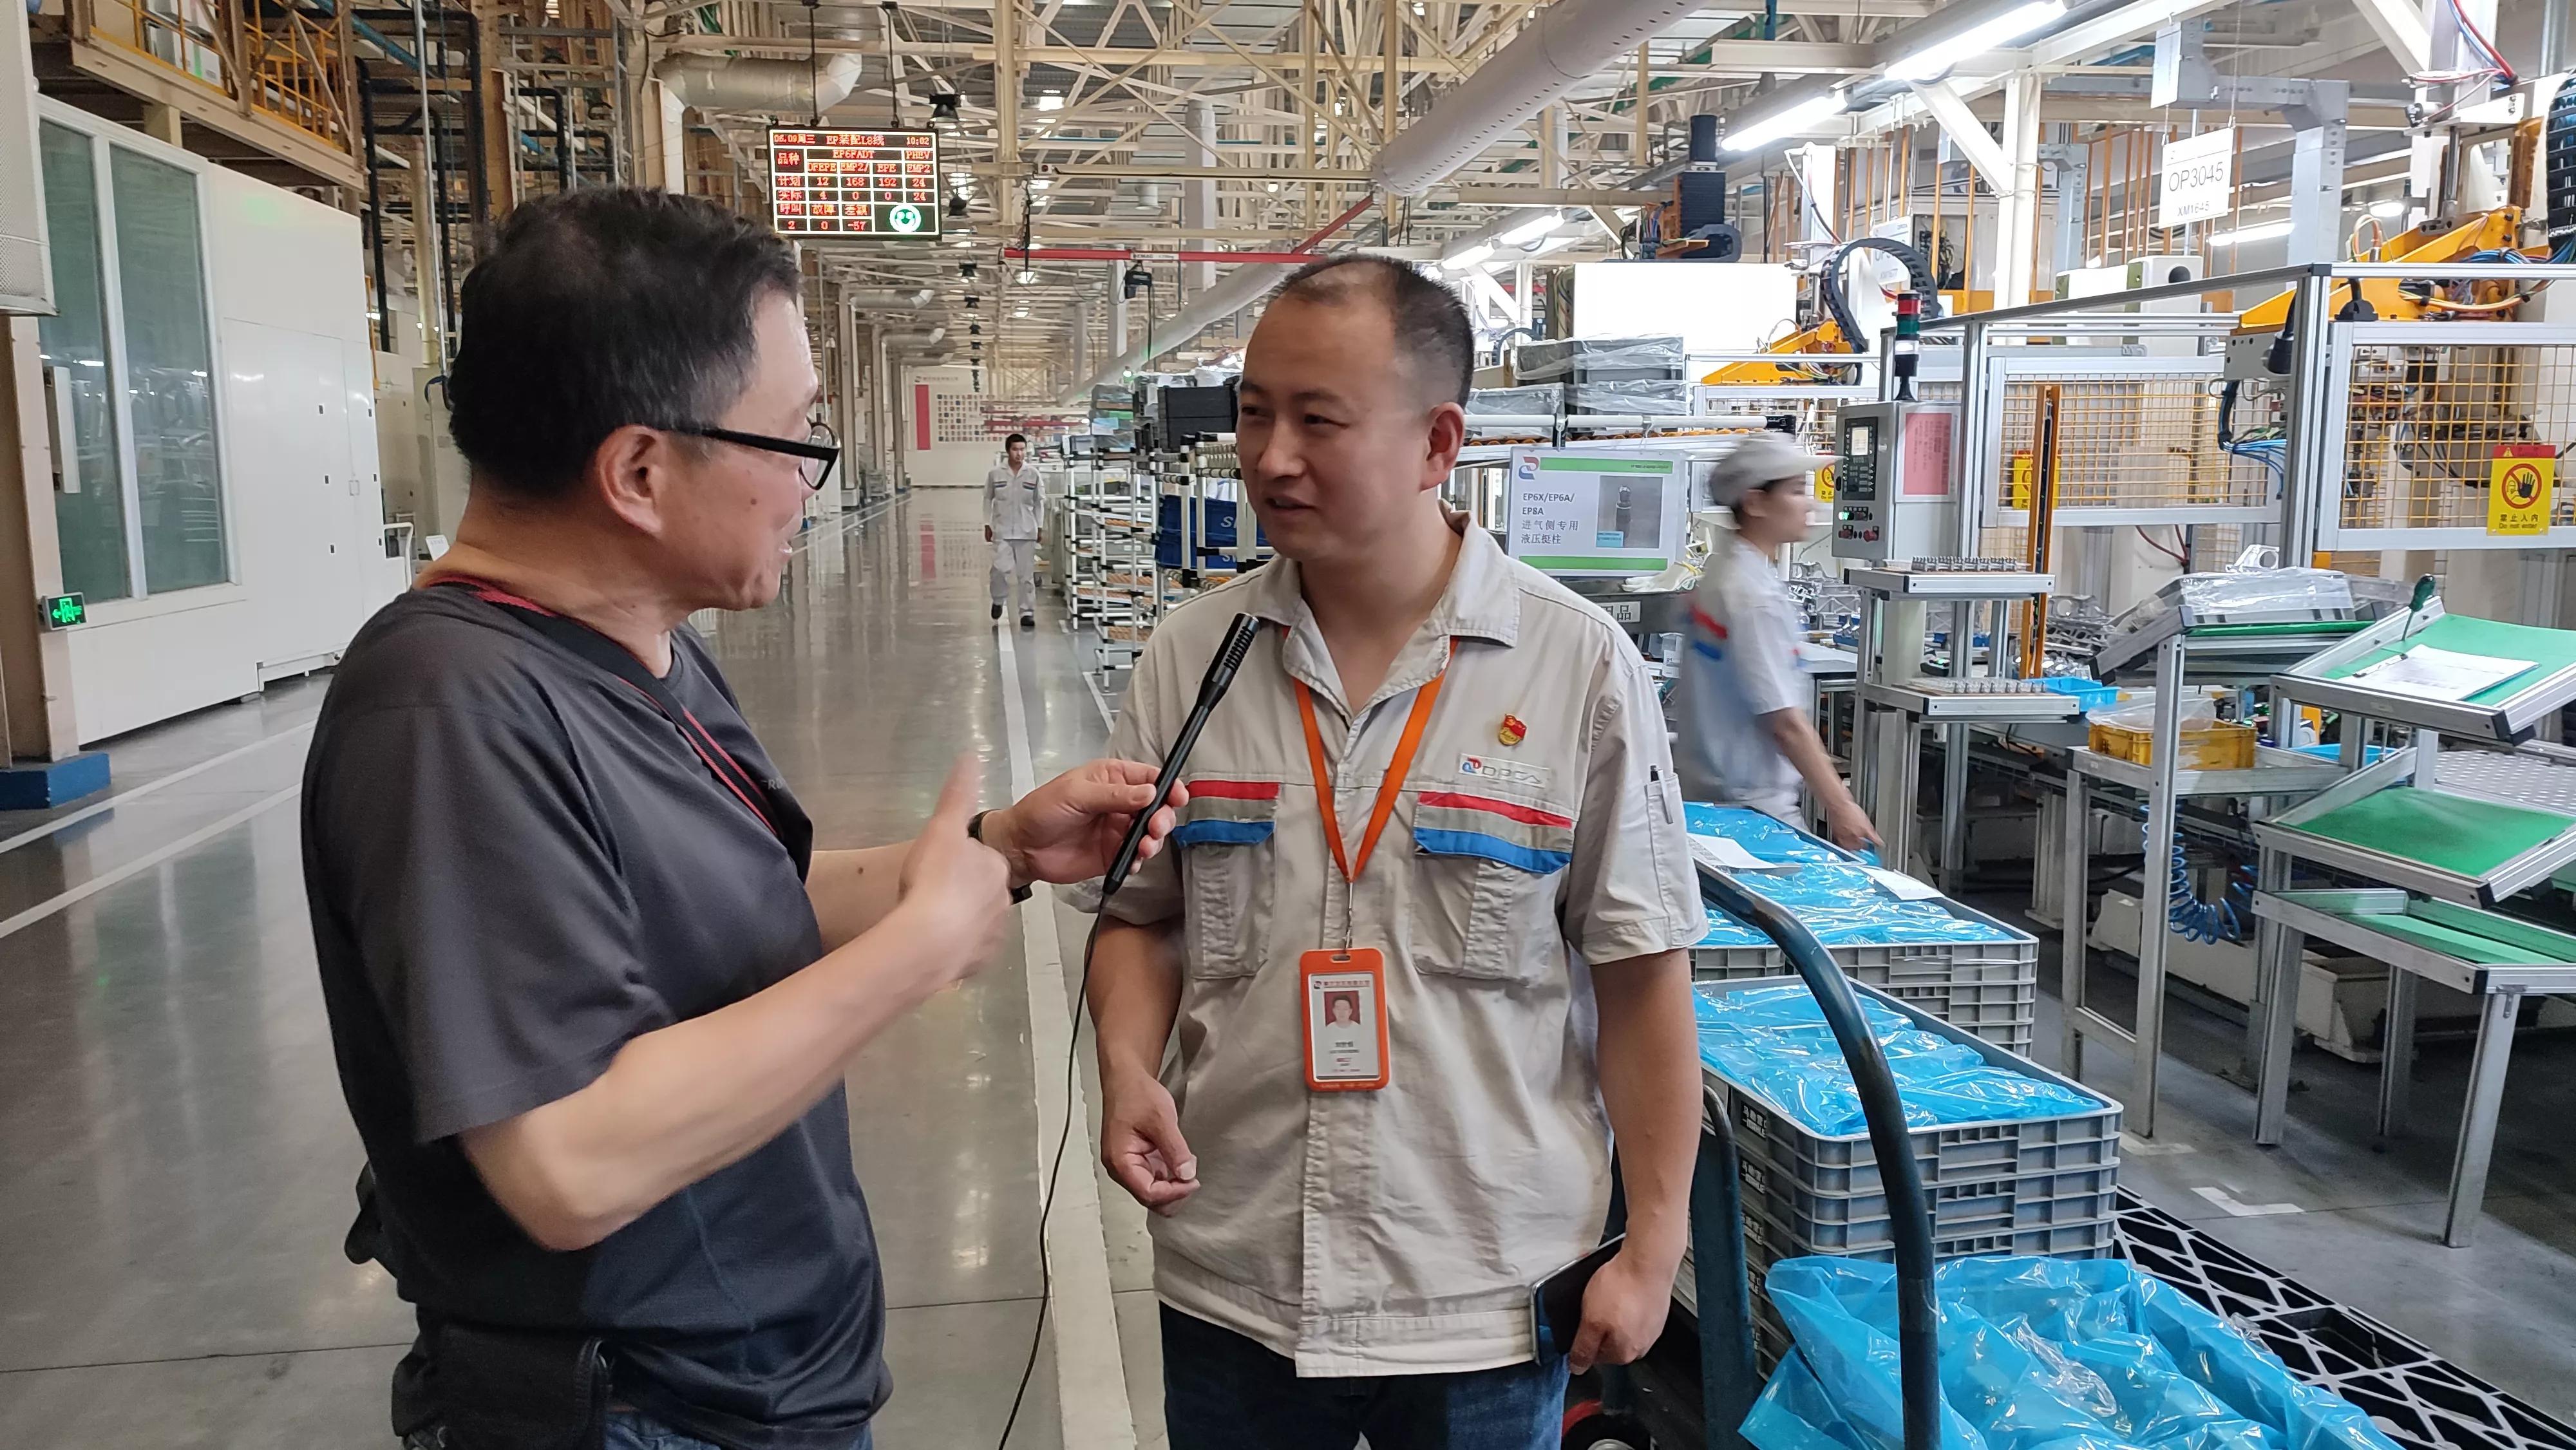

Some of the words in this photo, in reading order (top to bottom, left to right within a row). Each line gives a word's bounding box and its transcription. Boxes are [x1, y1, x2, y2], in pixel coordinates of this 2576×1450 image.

[906, 137, 930, 146] 10:02
[777, 152, 800, 165] 品种
[905, 150, 931, 160] PHEV
[877, 164, 897, 173] EPE
[778, 175, 801, 186] 计划
[817, 177, 829, 186] 12
[846, 177, 865, 187] 168
[2168, 162, 2223, 192] OP3045
[878, 178, 896, 187] 192
[912, 178, 926, 187] 24
[778, 189, 802, 200] 实际
[819, 191, 828, 200] 4
[852, 191, 860, 200] 0
[884, 191, 892, 200] 0
[913, 191, 926, 201] 24
[780, 203, 802, 214] 呼叫
[811, 203, 835, 215] 故障
[788, 220, 796, 230] 2
[820, 220, 829, 230] 0
[848, 221, 866, 231] -57
[1522, 493, 1575, 503] EP6X/EP6A/
[1522, 507, 1544, 516] EP8A
[1521, 520, 1578, 531] 进气侧专用
